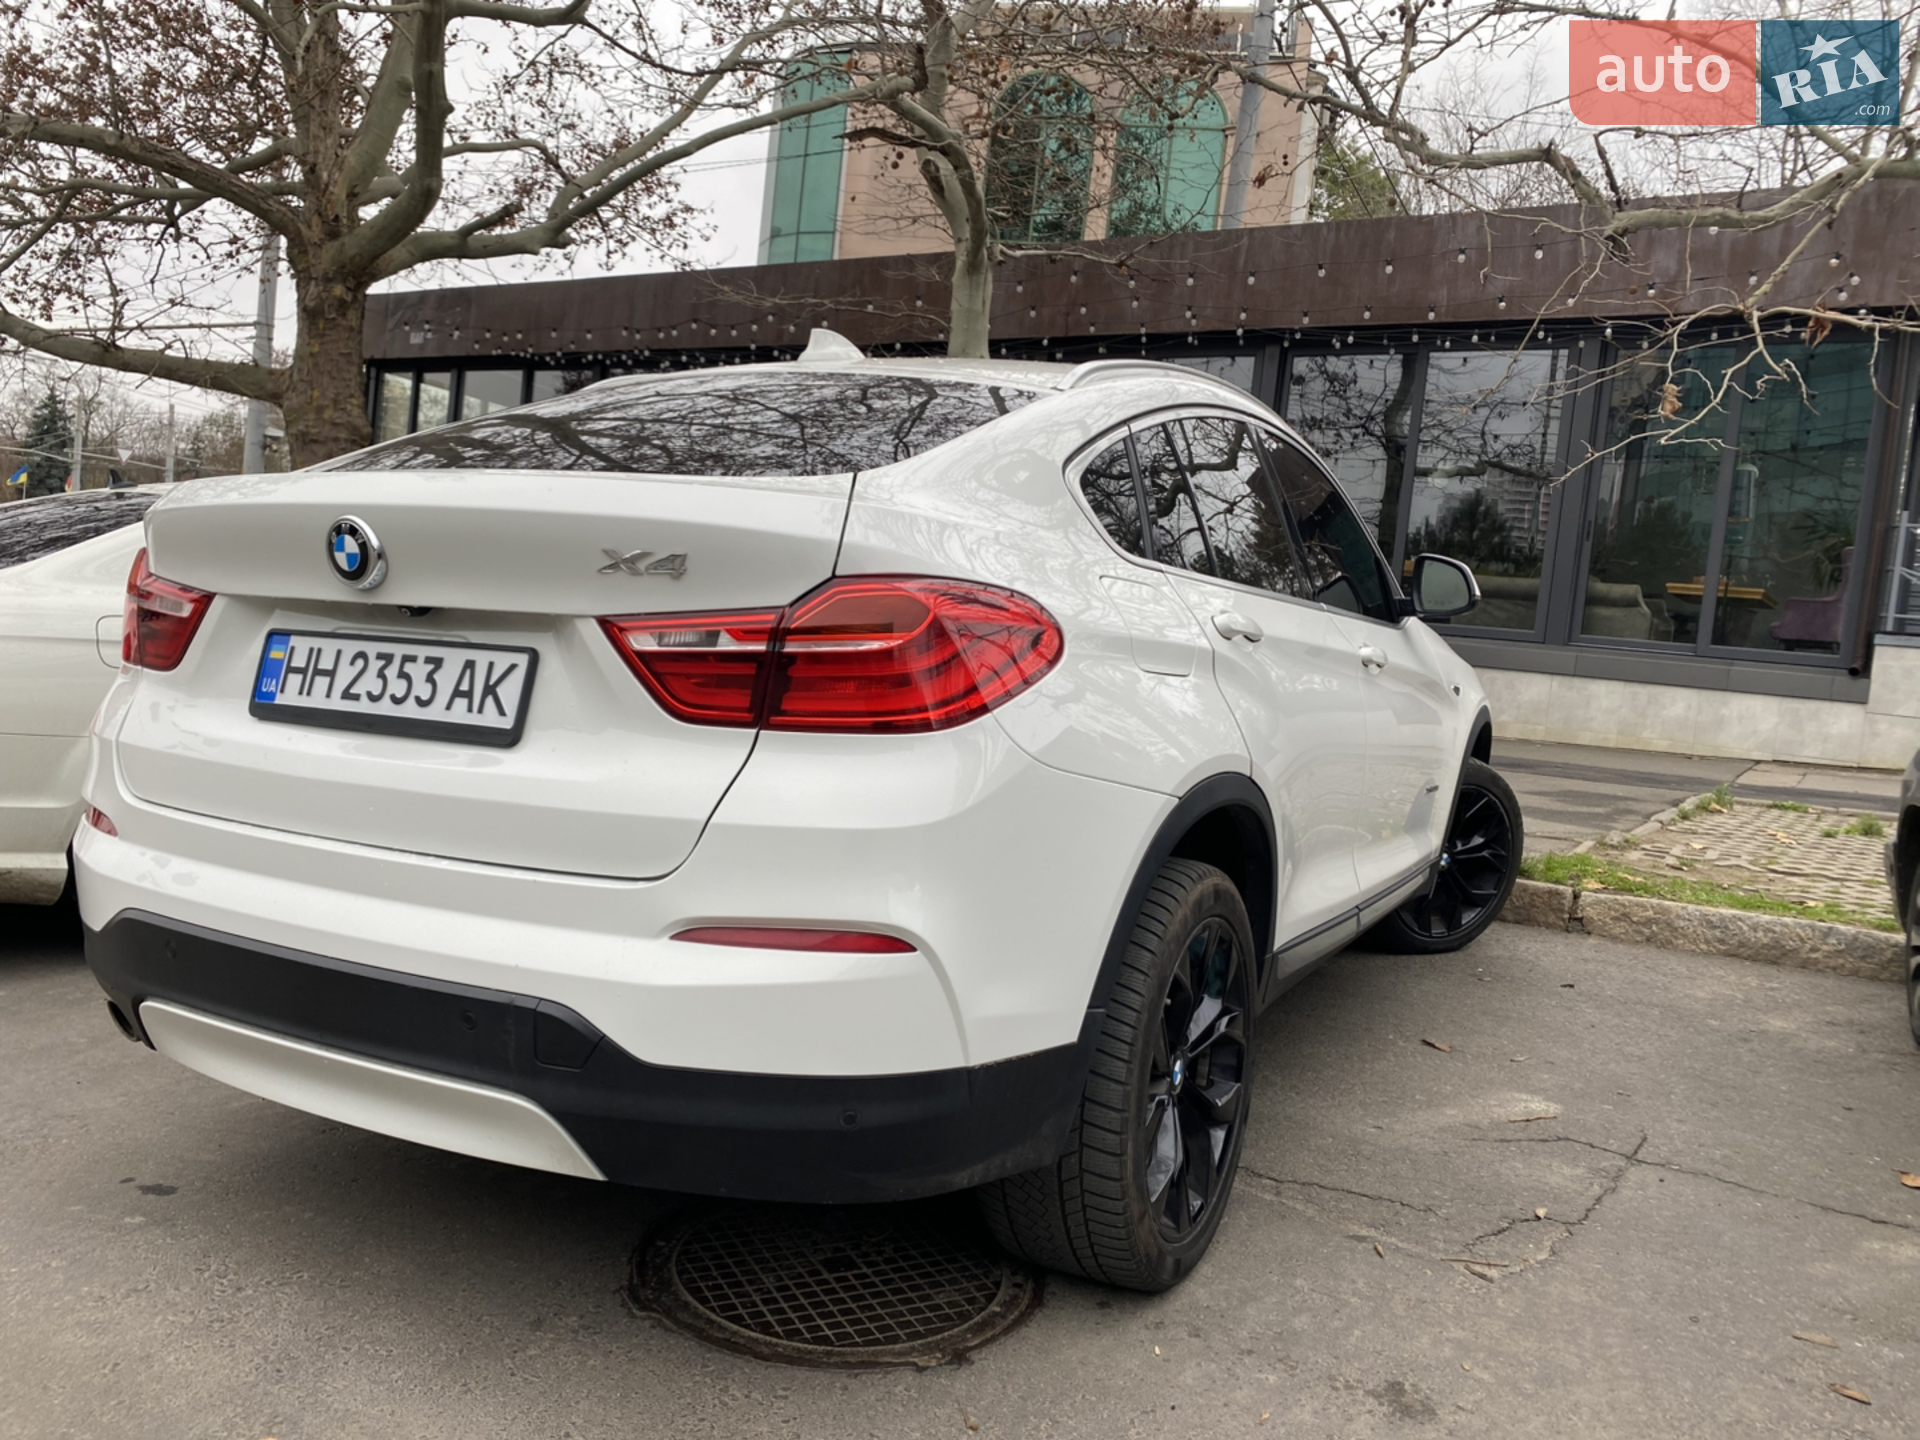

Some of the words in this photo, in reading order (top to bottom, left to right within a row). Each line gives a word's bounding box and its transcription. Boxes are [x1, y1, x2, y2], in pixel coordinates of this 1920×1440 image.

[597, 548, 688, 580] X4
[261, 677, 277, 693] UA
[340, 650, 444, 708] 2353
[445, 658, 519, 717] AK
